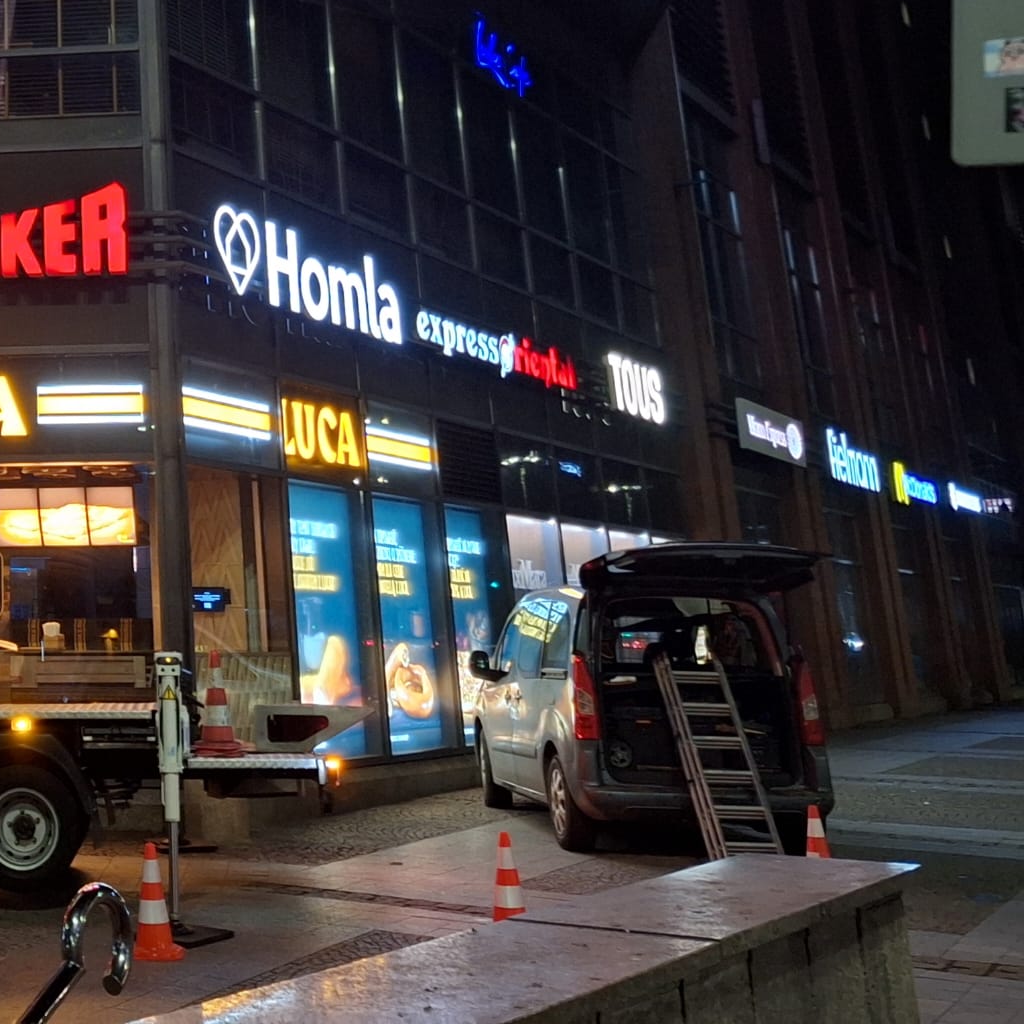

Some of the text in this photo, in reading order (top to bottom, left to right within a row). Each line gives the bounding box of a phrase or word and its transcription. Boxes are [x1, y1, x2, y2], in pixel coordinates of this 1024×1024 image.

[264, 219, 404, 345] Homla
[415, 308, 500, 366] express
[605, 351, 667, 426] TOUS
[280, 397, 361, 468] LUCA
